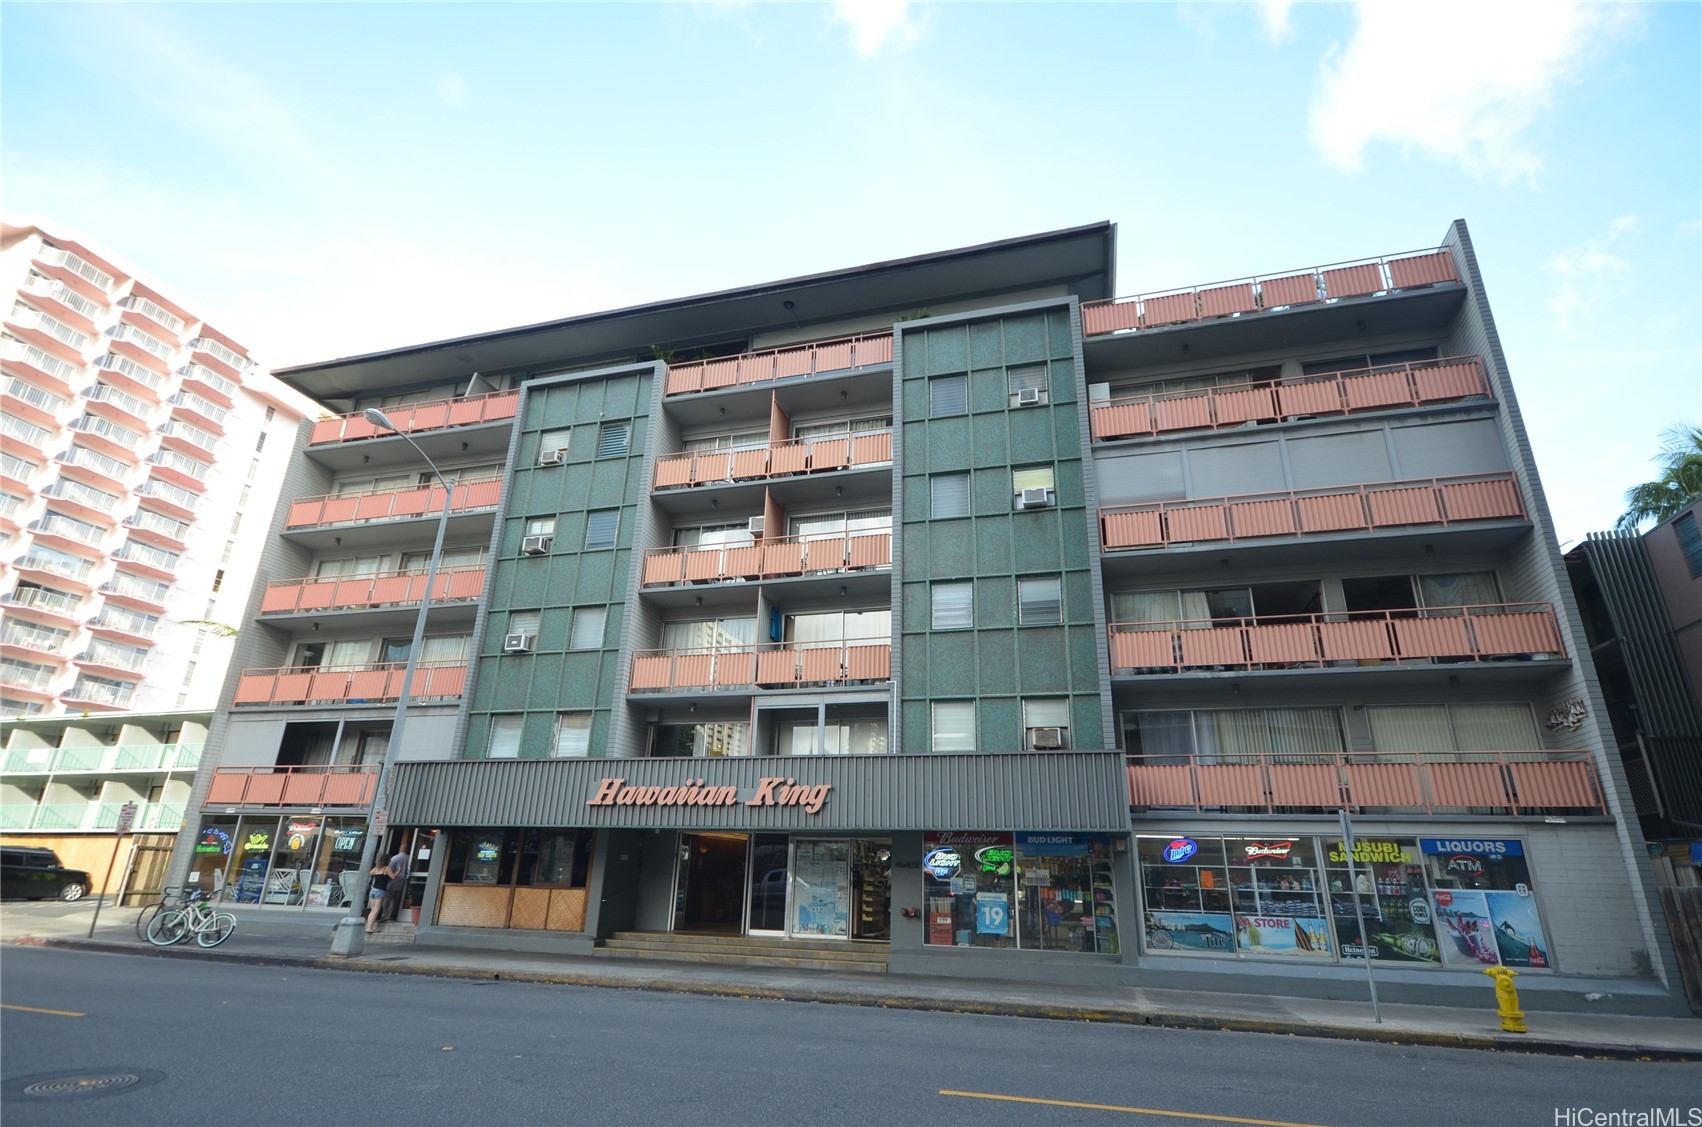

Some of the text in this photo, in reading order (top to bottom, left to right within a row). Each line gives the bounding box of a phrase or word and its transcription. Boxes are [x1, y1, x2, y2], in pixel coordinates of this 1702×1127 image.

[586, 777, 831, 813] Hawaiian King
[334, 836, 355, 849] OPEN
[936, 831, 999, 844] Budweiser
[1027, 836, 1073, 844] BUD LIGHT
[1436, 841, 1507, 853] LIQUORS
[1447, 859, 1482, 871] ATM
[1254, 917, 1290, 929] STORE
[1344, 945, 1376, 955] Heineen
